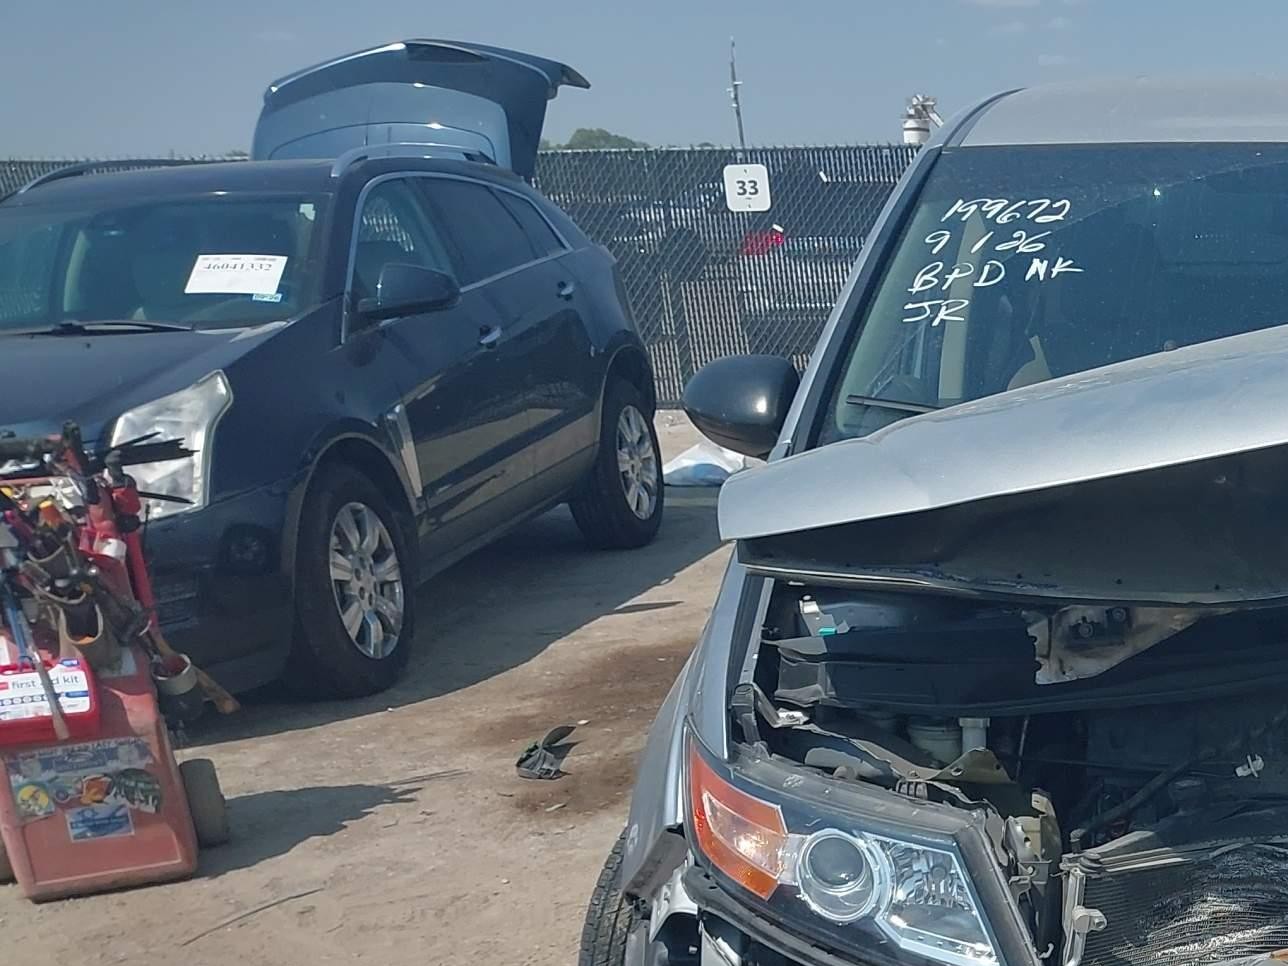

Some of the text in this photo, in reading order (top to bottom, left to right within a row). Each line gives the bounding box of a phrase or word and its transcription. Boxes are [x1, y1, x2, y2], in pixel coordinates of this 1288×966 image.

[736, 180, 759, 195] 33
[941, 199, 1071, 223] 199672
[925, 231, 951, 254] 9
[995, 231, 1052, 253] 26
[11, 679, 37, 690] first
[63, 675, 80, 684] kit
